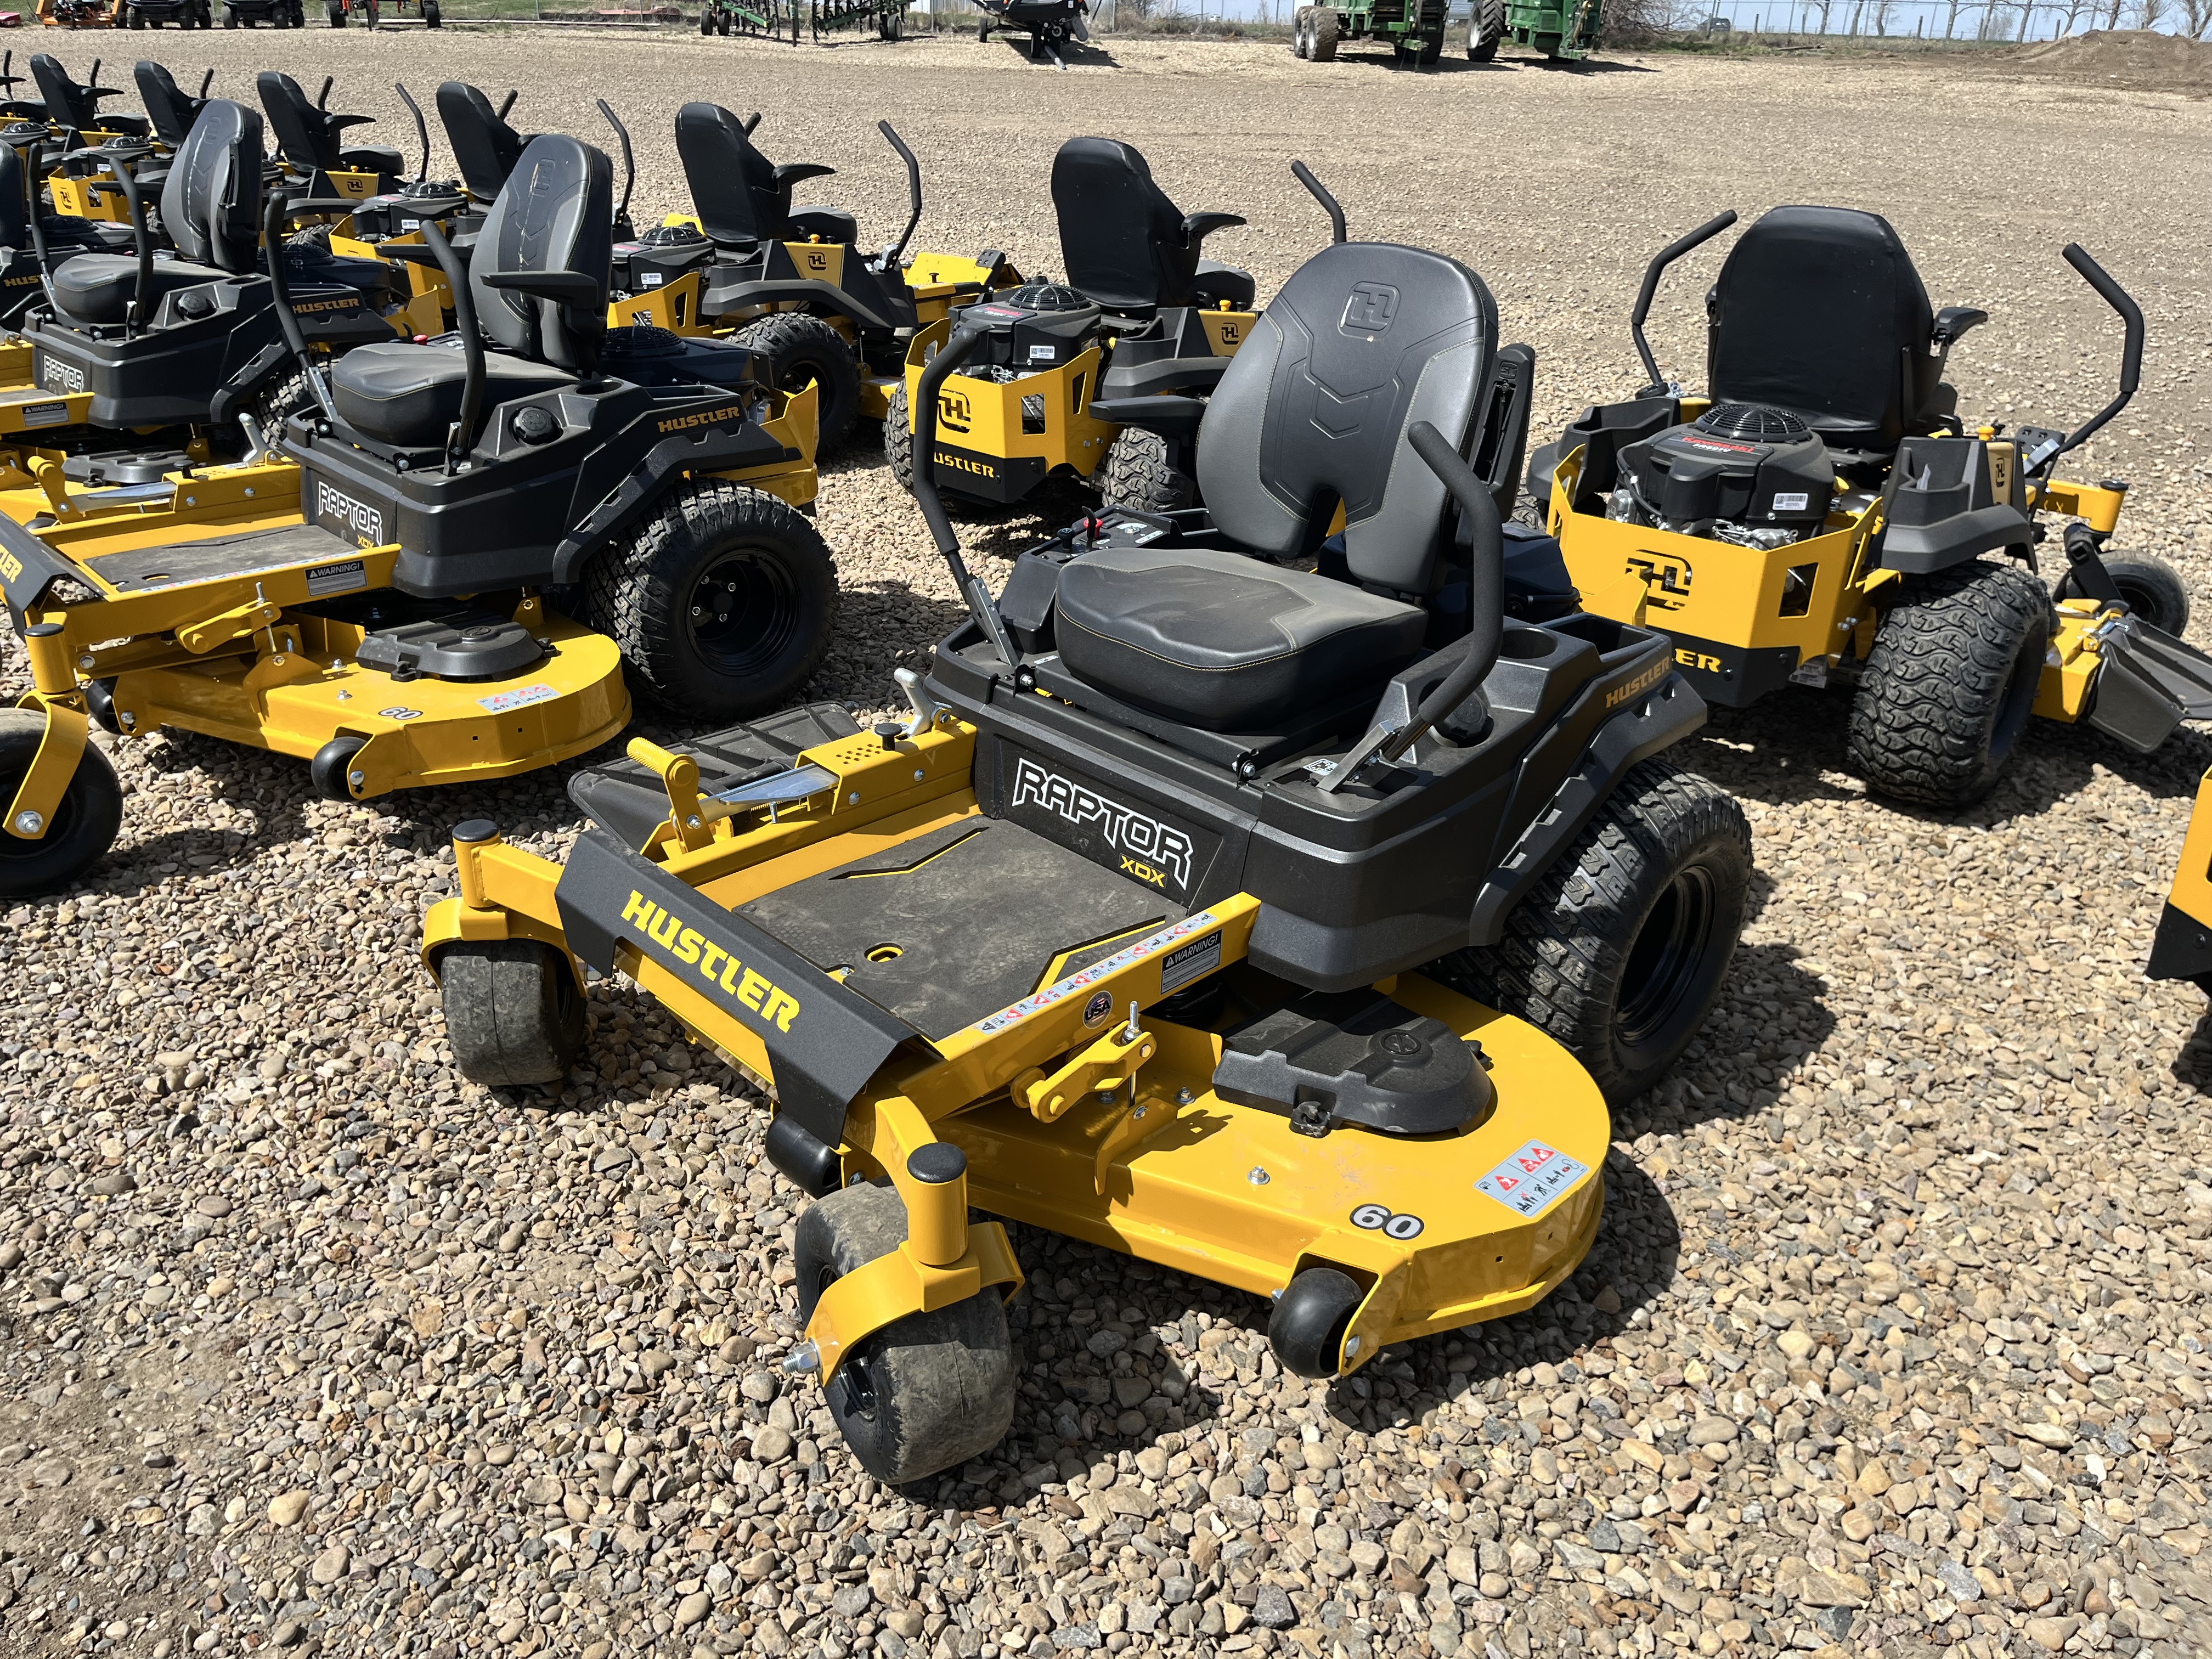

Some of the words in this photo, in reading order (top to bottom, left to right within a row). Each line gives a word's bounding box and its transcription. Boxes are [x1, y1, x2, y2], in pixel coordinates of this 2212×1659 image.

[292, 298, 360, 314] HUSTLER
[44, 355, 84, 393] RAPTOR
[31, 403, 64, 413] WARNING!
[658, 406, 740, 433] HUSTLER
[934, 452, 994, 478] USTLER
[318, 481, 382, 547] RAPTOR
[357, 534, 374, 549] XDX
[317, 562, 360, 577] WARNING!
[1606, 656, 1670, 709] HUSTLER
[379, 707, 424, 720] 60
[1012, 758, 1194, 891] RAPTOR
[1119, 855, 1166, 888] XDX
[620, 889, 801, 1034] HUSTLER
[1175, 933, 1218, 963] WARNING!
[1085, 1000, 1111, 1021] USA
[1349, 1204, 1425, 1240] 60
